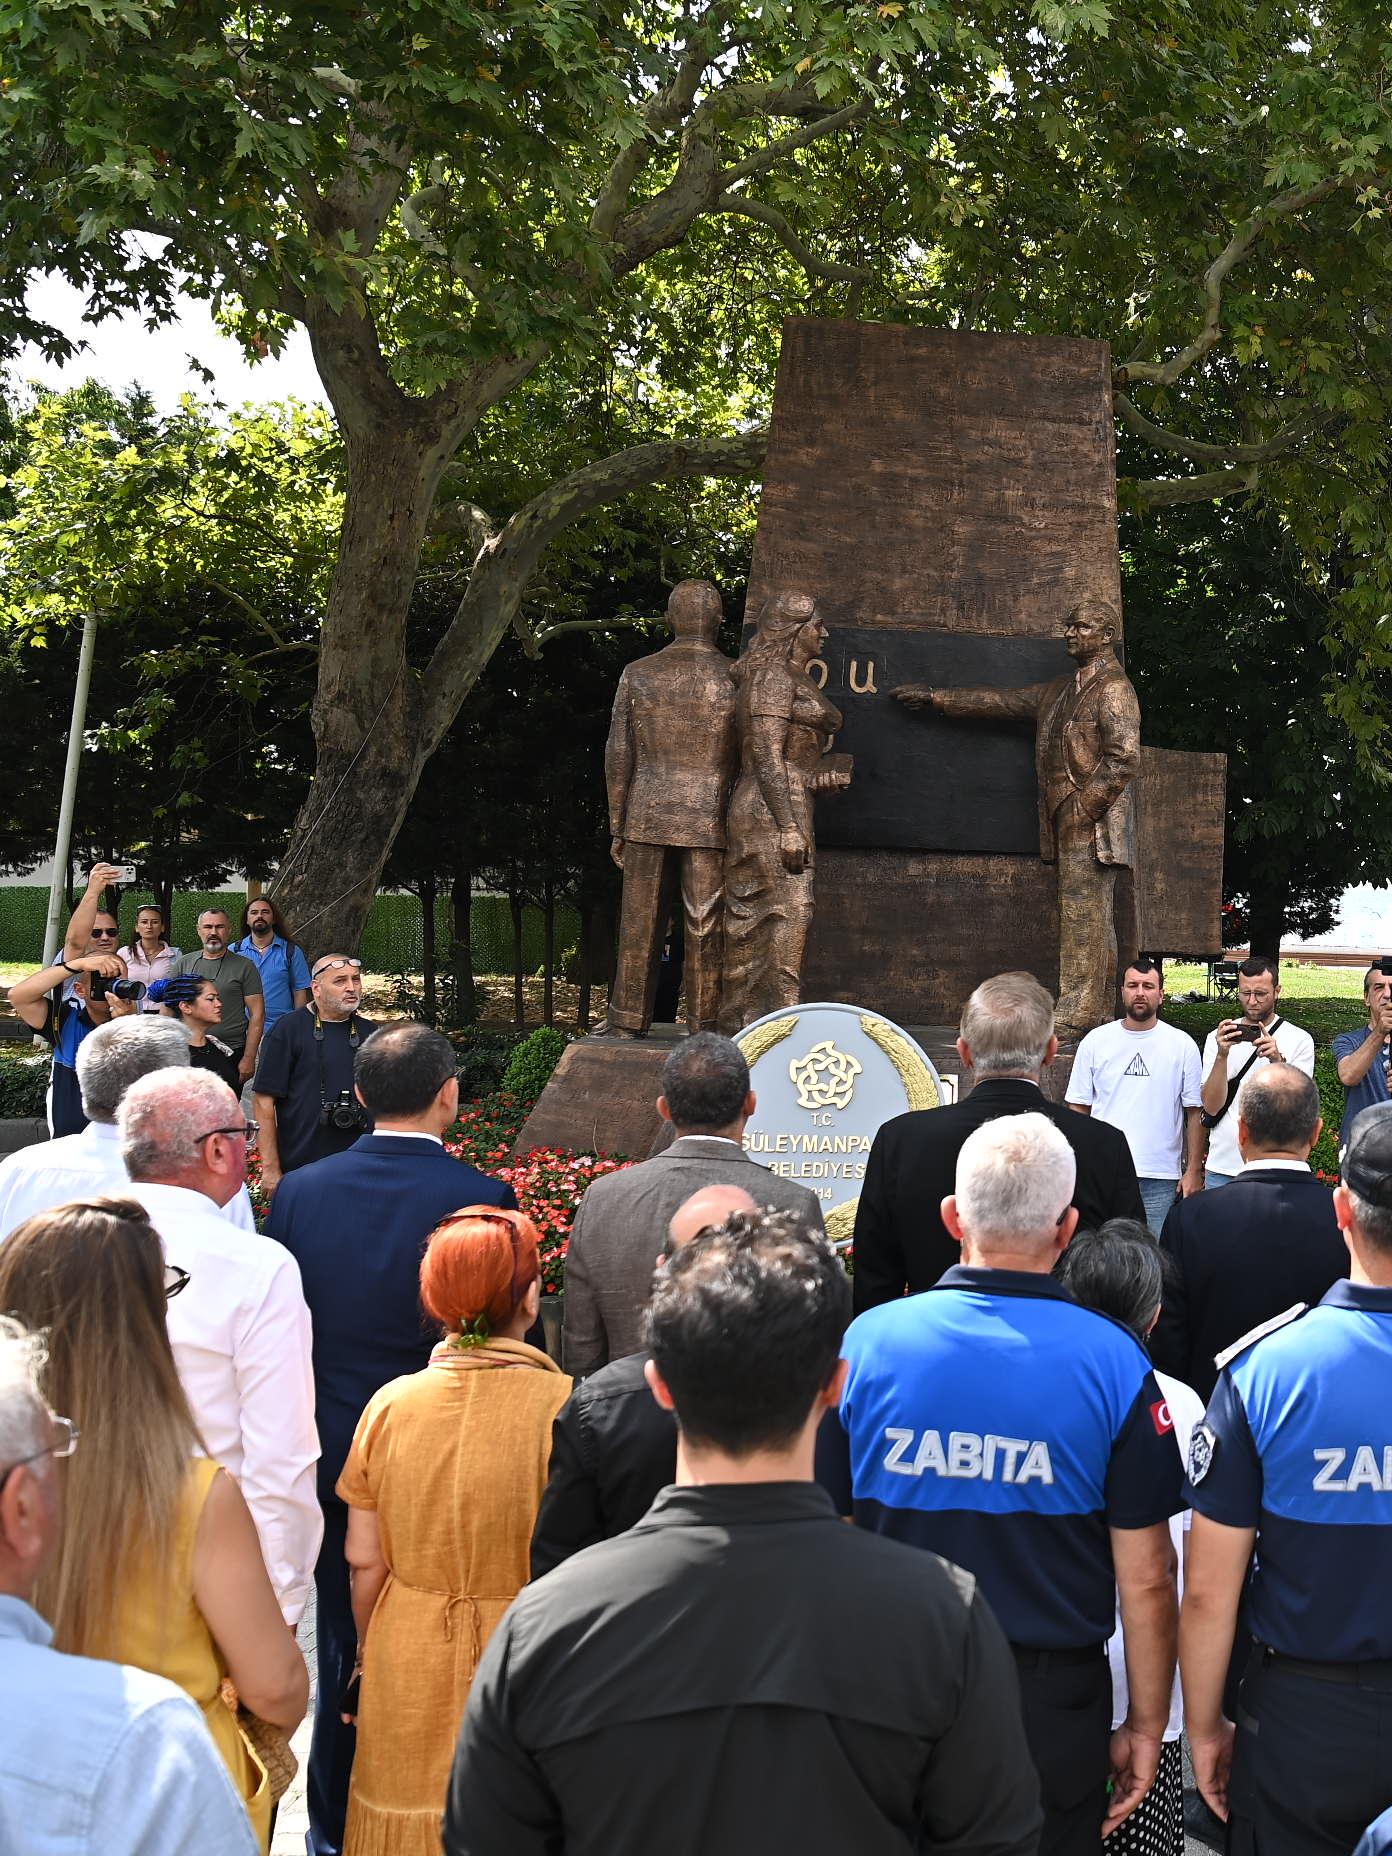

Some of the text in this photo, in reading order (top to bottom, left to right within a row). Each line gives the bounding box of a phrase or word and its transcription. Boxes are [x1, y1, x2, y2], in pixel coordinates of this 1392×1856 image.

[849, 660, 878, 694] u
[810, 1112, 834, 1127] T.C.
[742, 1130, 872, 1153] SÜLEYMANPA
[767, 1159, 866, 1179] BELEDİYES
[883, 1427, 1054, 1485] ZABITA
